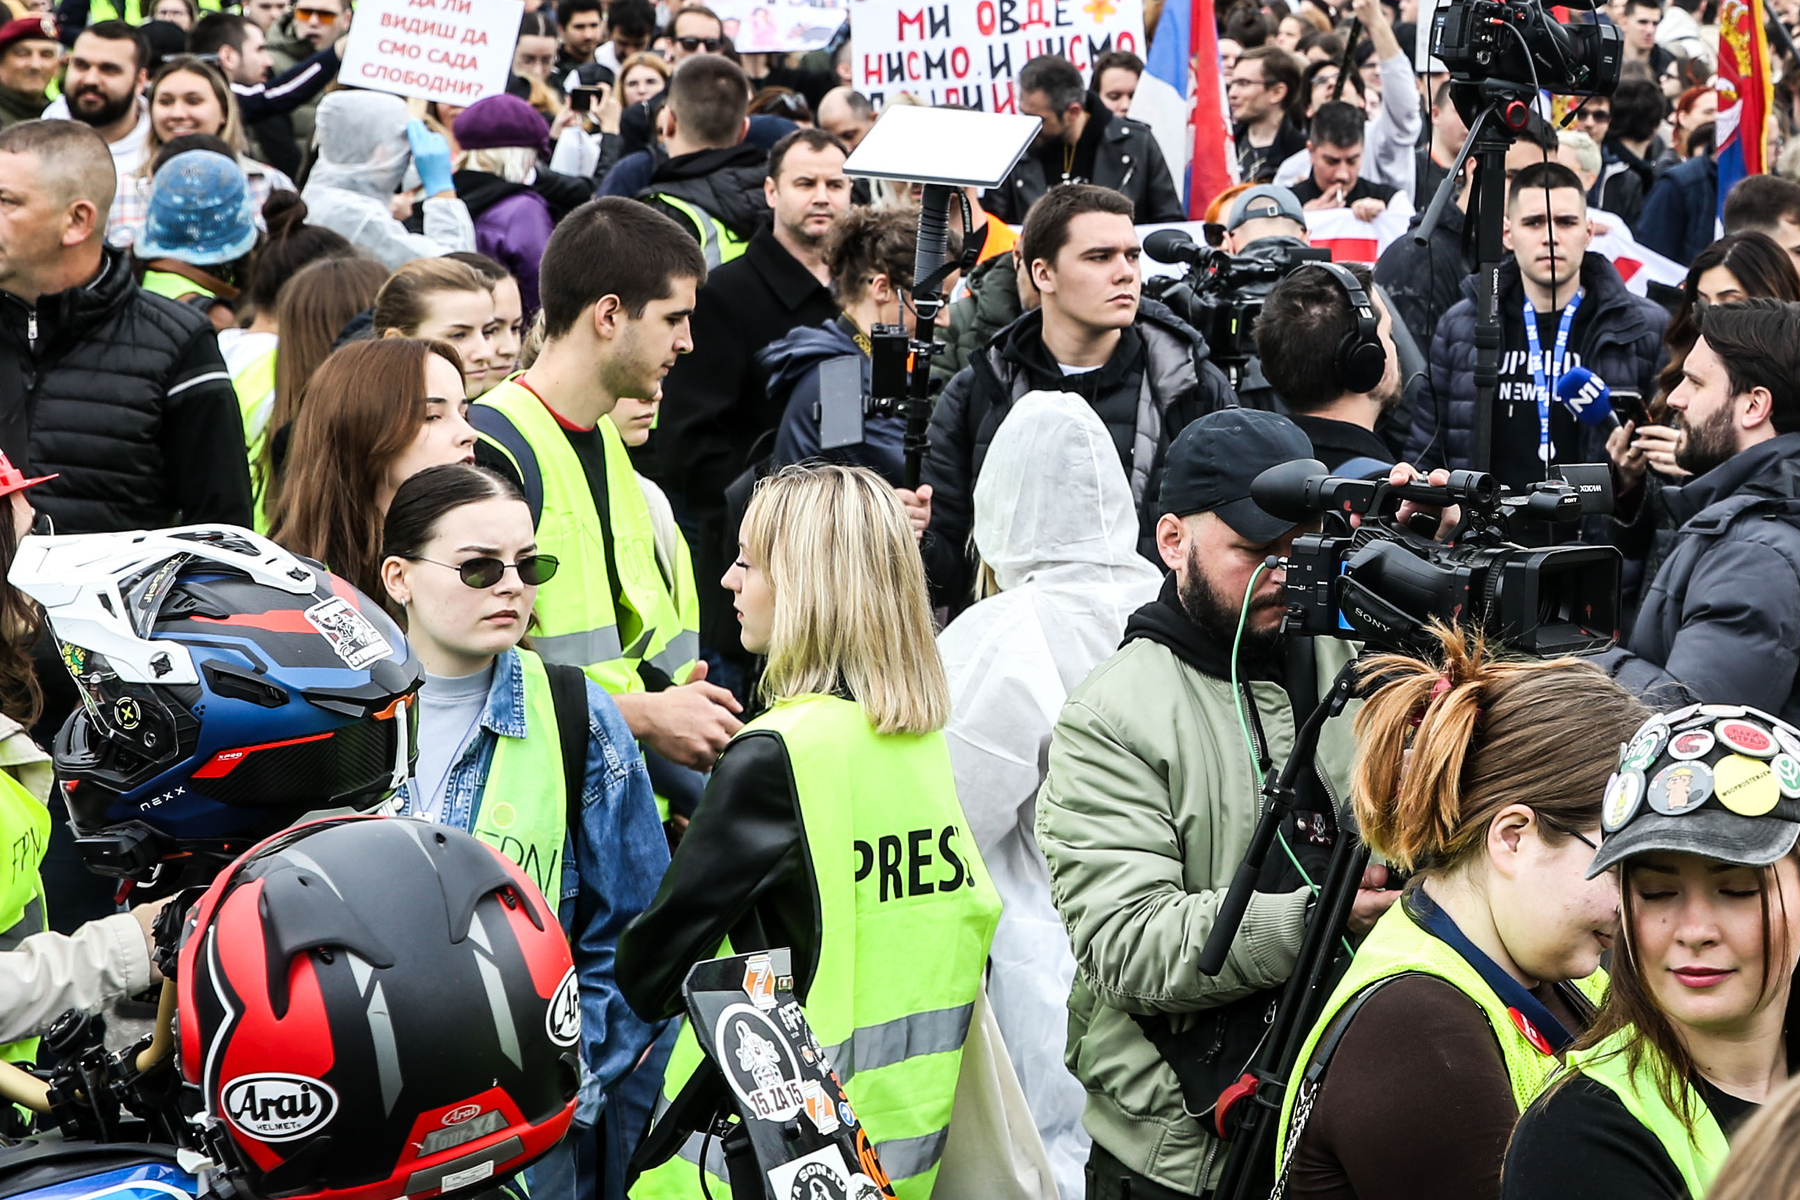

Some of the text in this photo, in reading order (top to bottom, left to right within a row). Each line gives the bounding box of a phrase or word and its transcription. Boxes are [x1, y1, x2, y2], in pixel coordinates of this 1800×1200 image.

[380, 13, 488, 46] ВИДИШ ДА
[897, 4, 950, 42] МИ
[378, 39, 478, 70] СМО САДА
[988, 42, 1013, 79] И
[361, 63, 484, 97] СЛОБОДНИ?
[1569, 382, 1600, 413] N1
[1355, 607, 1391, 632] SONY
[12, 827, 42, 885] FPN
[853, 824, 976, 903] PRES
[232, 1082, 318, 1123] Arai
[772, 1088, 789, 1110] ZA
[789, 1083, 804, 1107] 15
[257, 1121, 297, 1132] HELMET
[446, 1105, 478, 1122] Arai
[428, 1113, 499, 1151] Tour-X4
